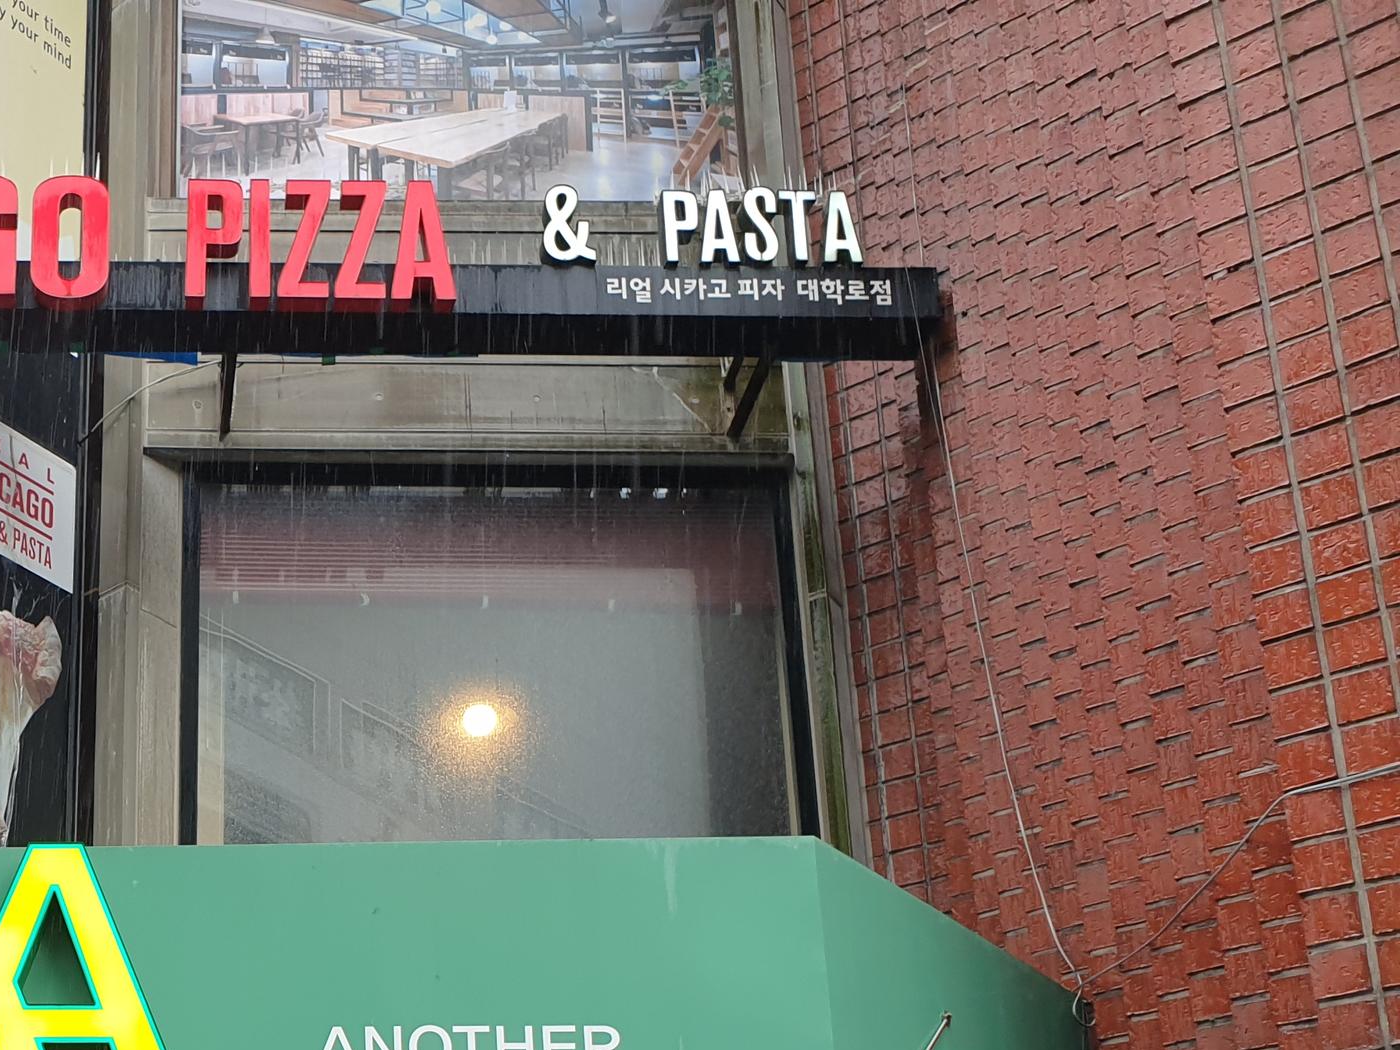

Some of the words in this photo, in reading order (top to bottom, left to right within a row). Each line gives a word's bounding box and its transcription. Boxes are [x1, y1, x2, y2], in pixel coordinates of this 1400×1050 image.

[10, 15, 39, 43] your
[43, 40, 72, 70] mind
[43, 15, 71, 48] time
[185, 178, 458, 301] PIZZA
[540, 184, 598, 264] &
[662, 186, 865, 266] PASTA
[606, 277, 652, 303] 리얼
[659, 277, 732, 301] 시카고
[737, 277, 785, 301] 피자
[796, 278, 893, 306] 대학로점
[12, 527, 53, 570] PASTA
